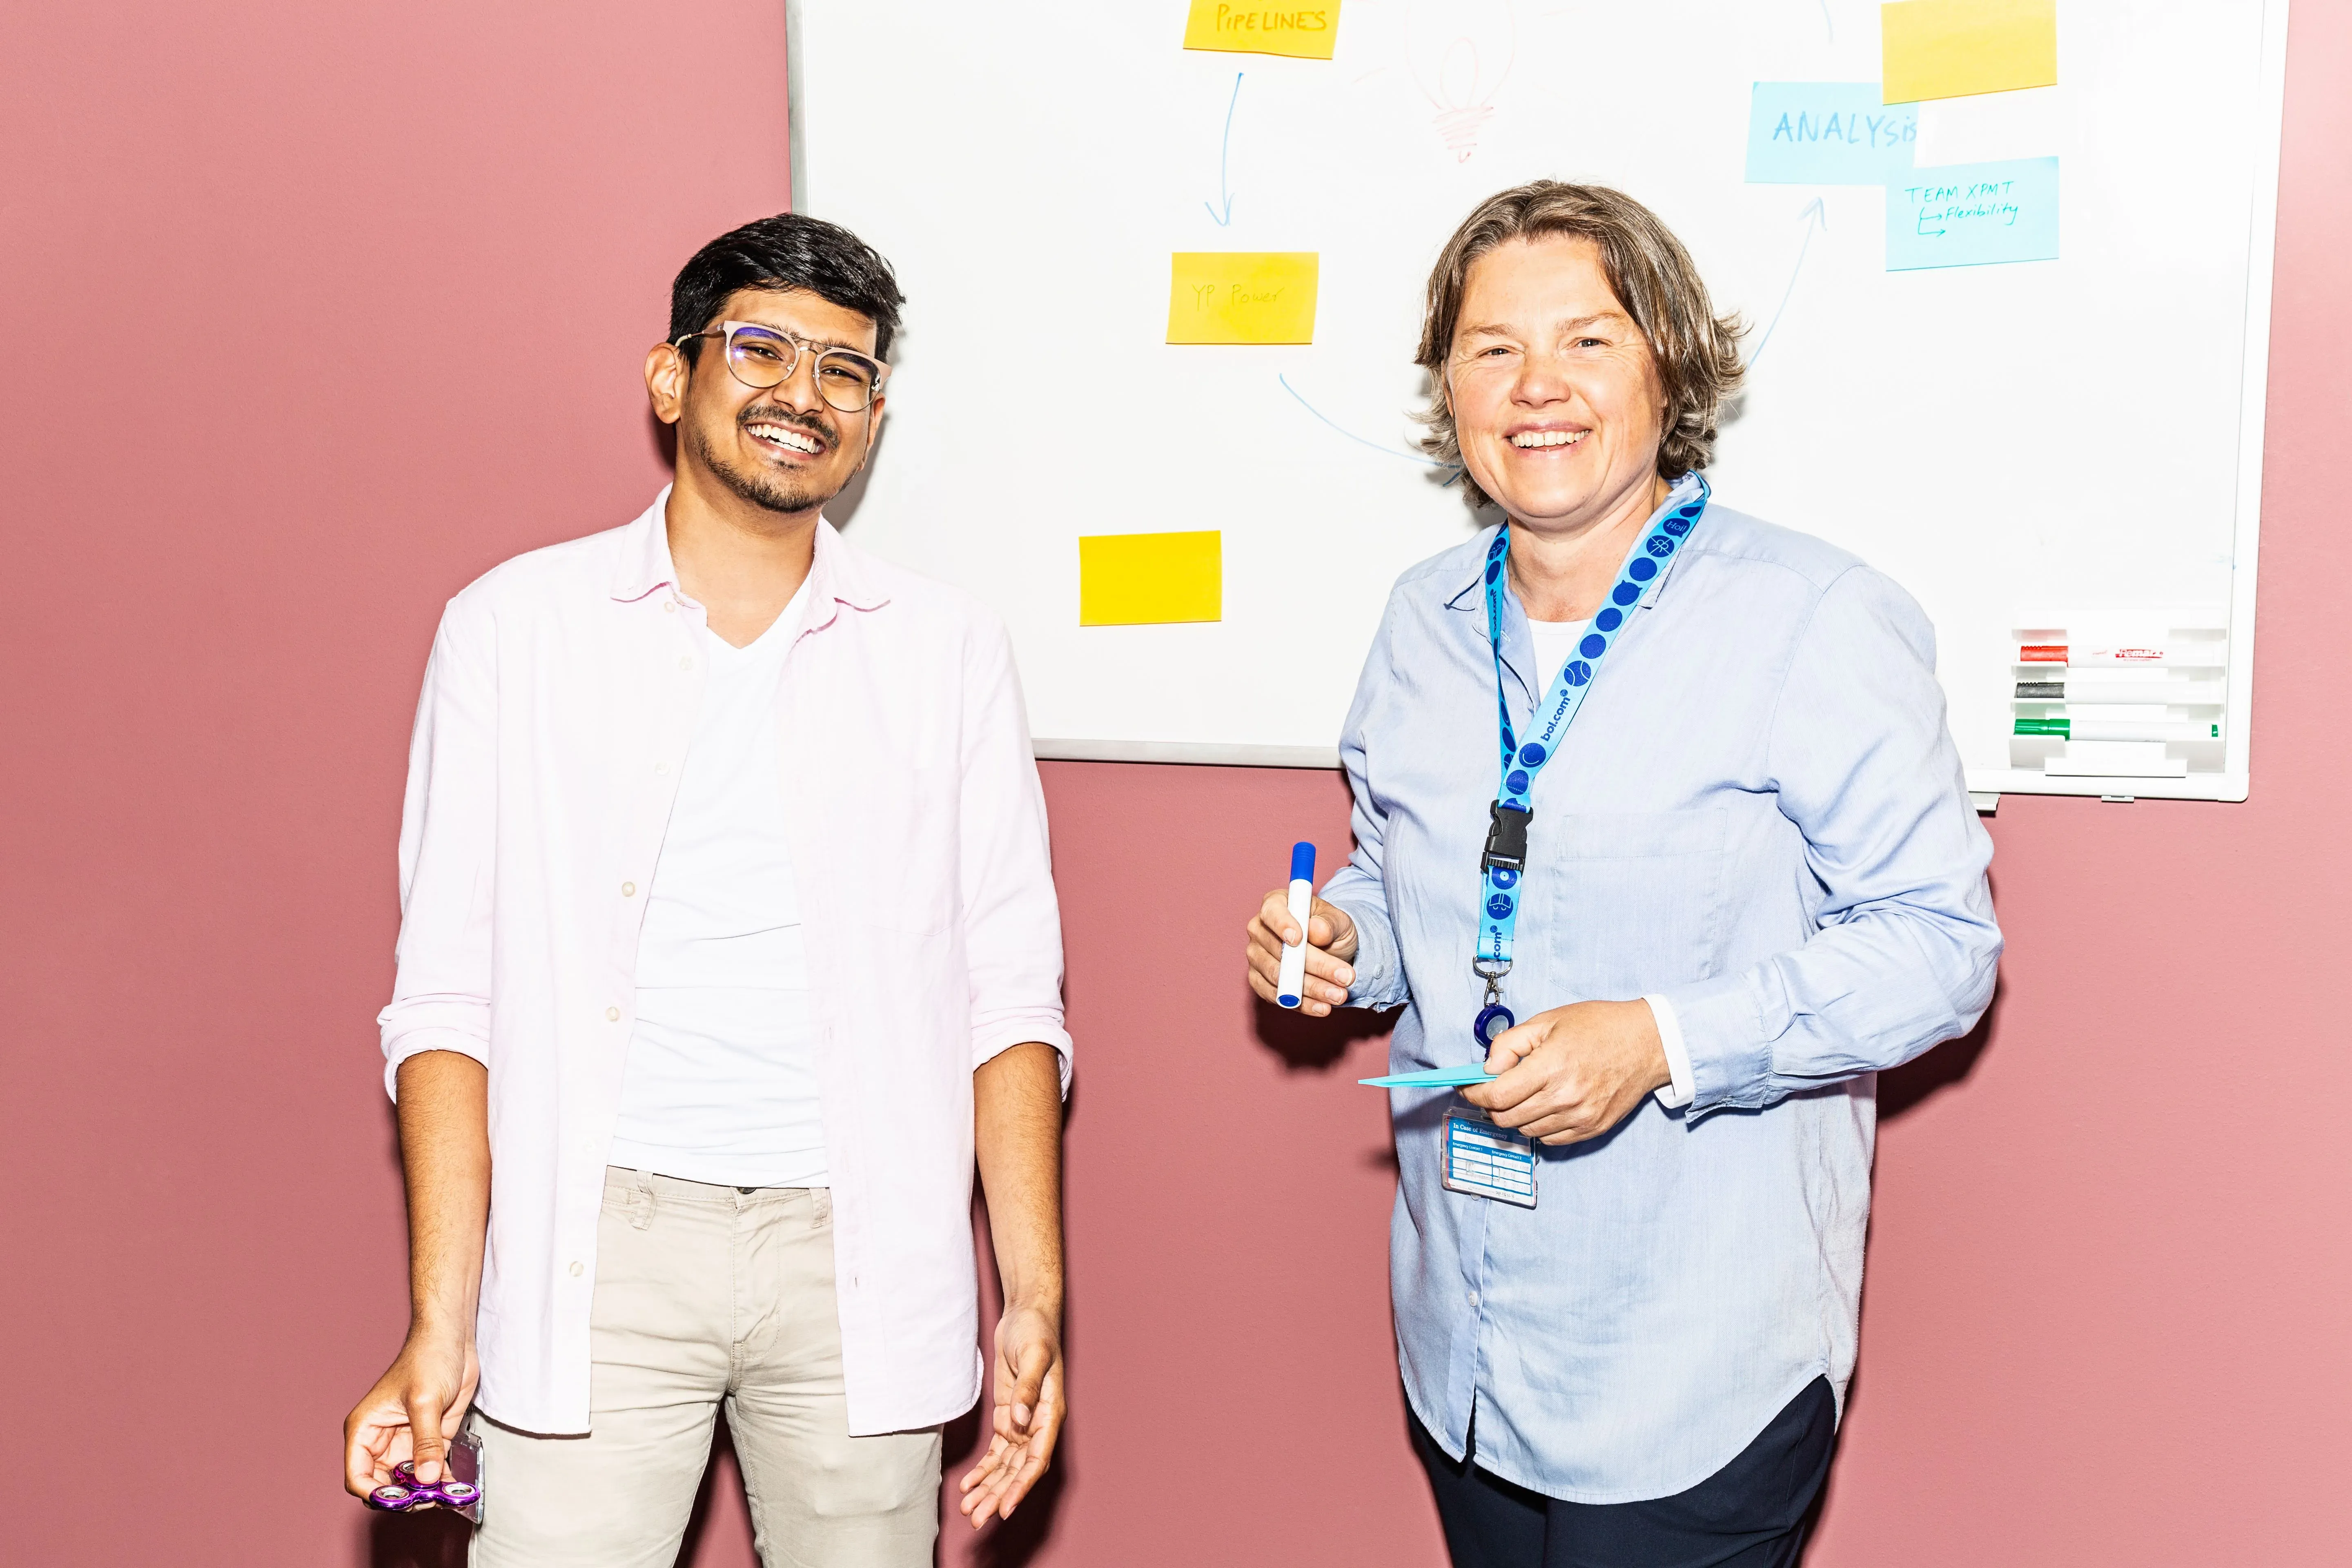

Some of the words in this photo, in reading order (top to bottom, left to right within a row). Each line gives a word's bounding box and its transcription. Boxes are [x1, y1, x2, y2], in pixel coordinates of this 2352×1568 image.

[1904, 186, 1958, 204] TEAM
[1945, 203, 2018, 226] Flexibility
[1192, 283, 1215, 312] YP
[1232, 283, 1285, 307] Power
[1666, 521, 1687, 532] Hoi!
[1540, 697, 1571, 742] bol.com
[1479, 1128, 1508, 1140] Emergency
